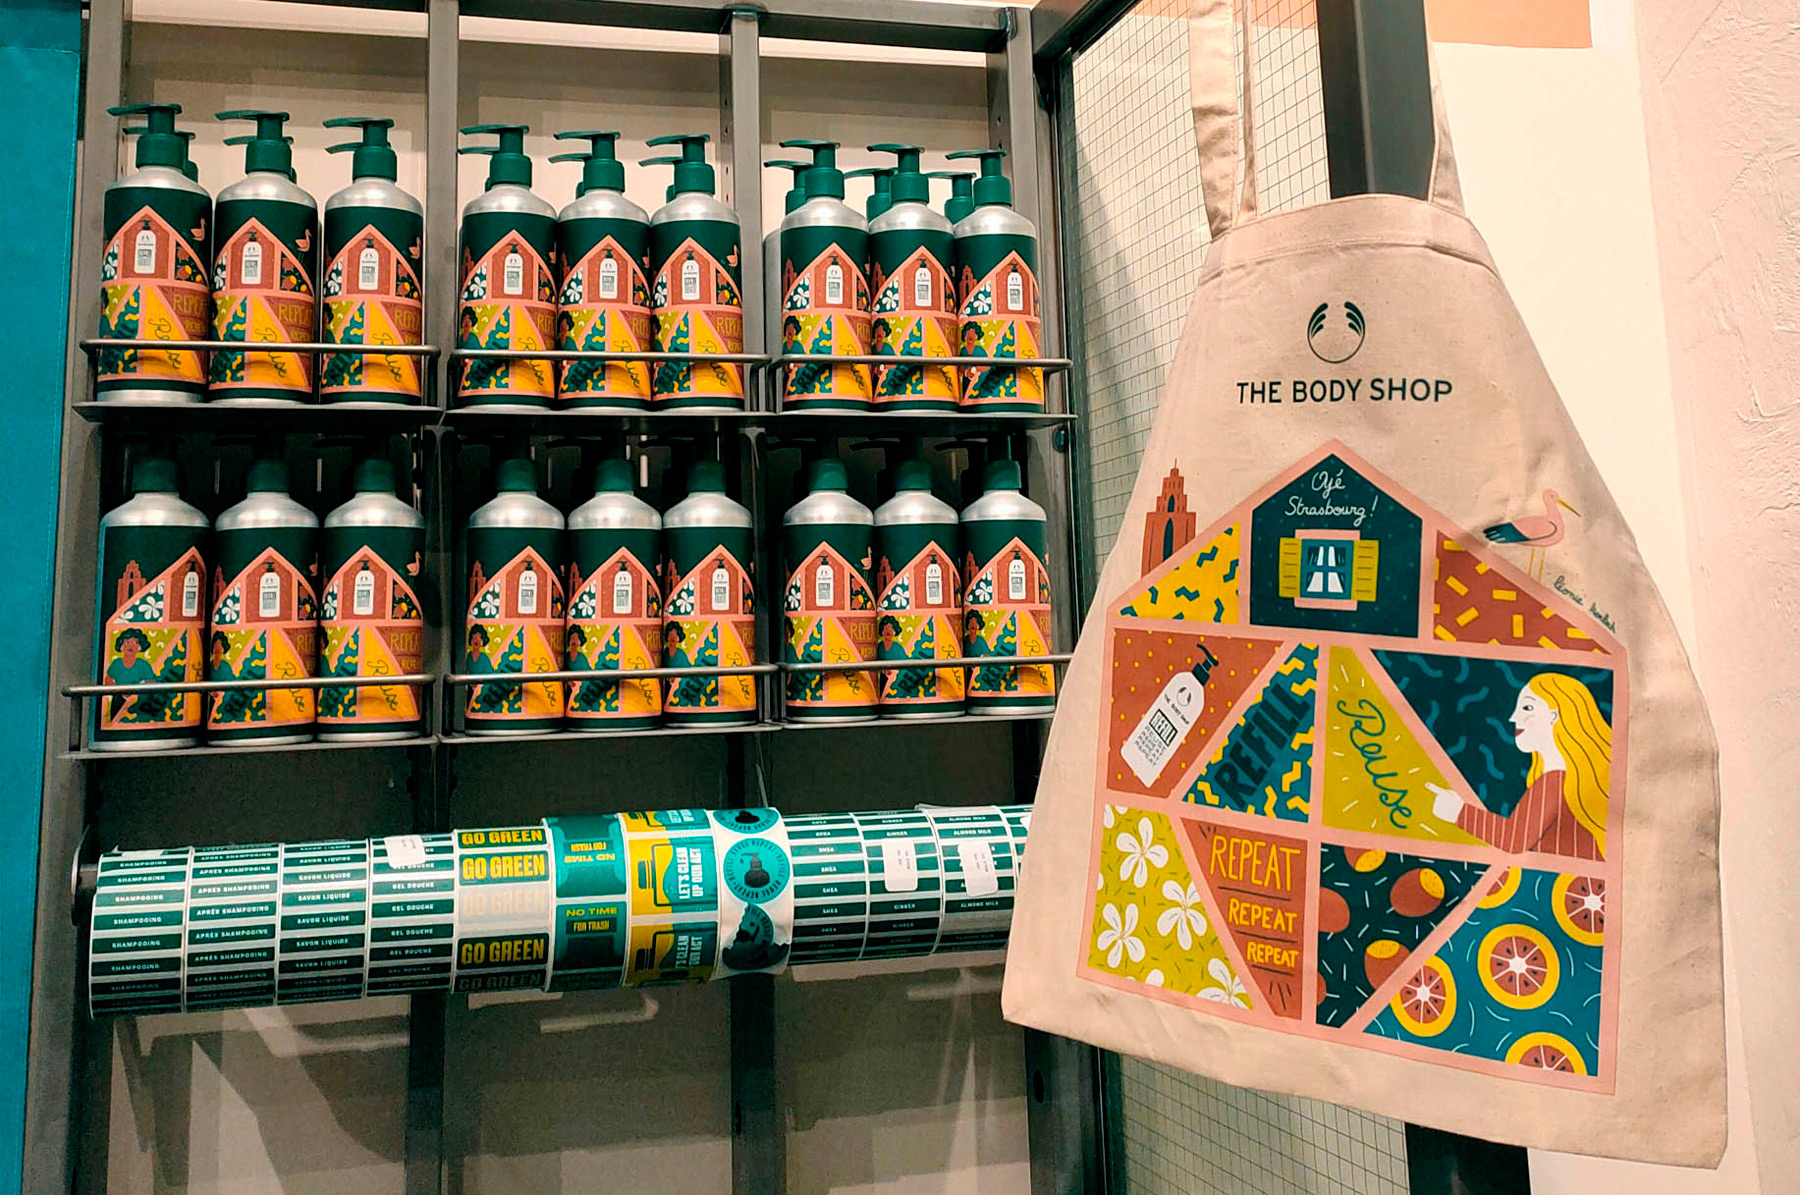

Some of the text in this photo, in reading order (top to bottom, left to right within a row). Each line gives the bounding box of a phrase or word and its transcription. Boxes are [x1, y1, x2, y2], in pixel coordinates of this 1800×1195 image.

[1236, 378, 1452, 404] THE BODY SHOP
[1284, 496, 1366, 527] Strasbourg
[1214, 682, 1310, 810] REFILL
[1337, 699, 1412, 830] Reuse
[462, 830, 543, 845] GO GREEN
[462, 854, 546, 880] GO GREEN
[676, 847, 690, 900] LET'S CLEAN
[690, 848, 704, 898] UP OUR ACT
[1210, 835, 1302, 892] REPEAT
[116, 894, 164, 902] SHAMPOOING
[222, 906, 270, 914] SHAMPOOING
[114, 916, 162, 925] SHAMPOOING
[566, 908, 617, 917] NO TIME
[1228, 898, 1298, 934] REPEAT
[221, 929, 268, 938] SHAMPOOING
[574, 920, 610, 933] FOR TRASH
[112, 940, 160, 948] SHAMPOOING
[461, 938, 544, 966] GO GREEN
[1246, 941, 1300, 968] REPEAT
